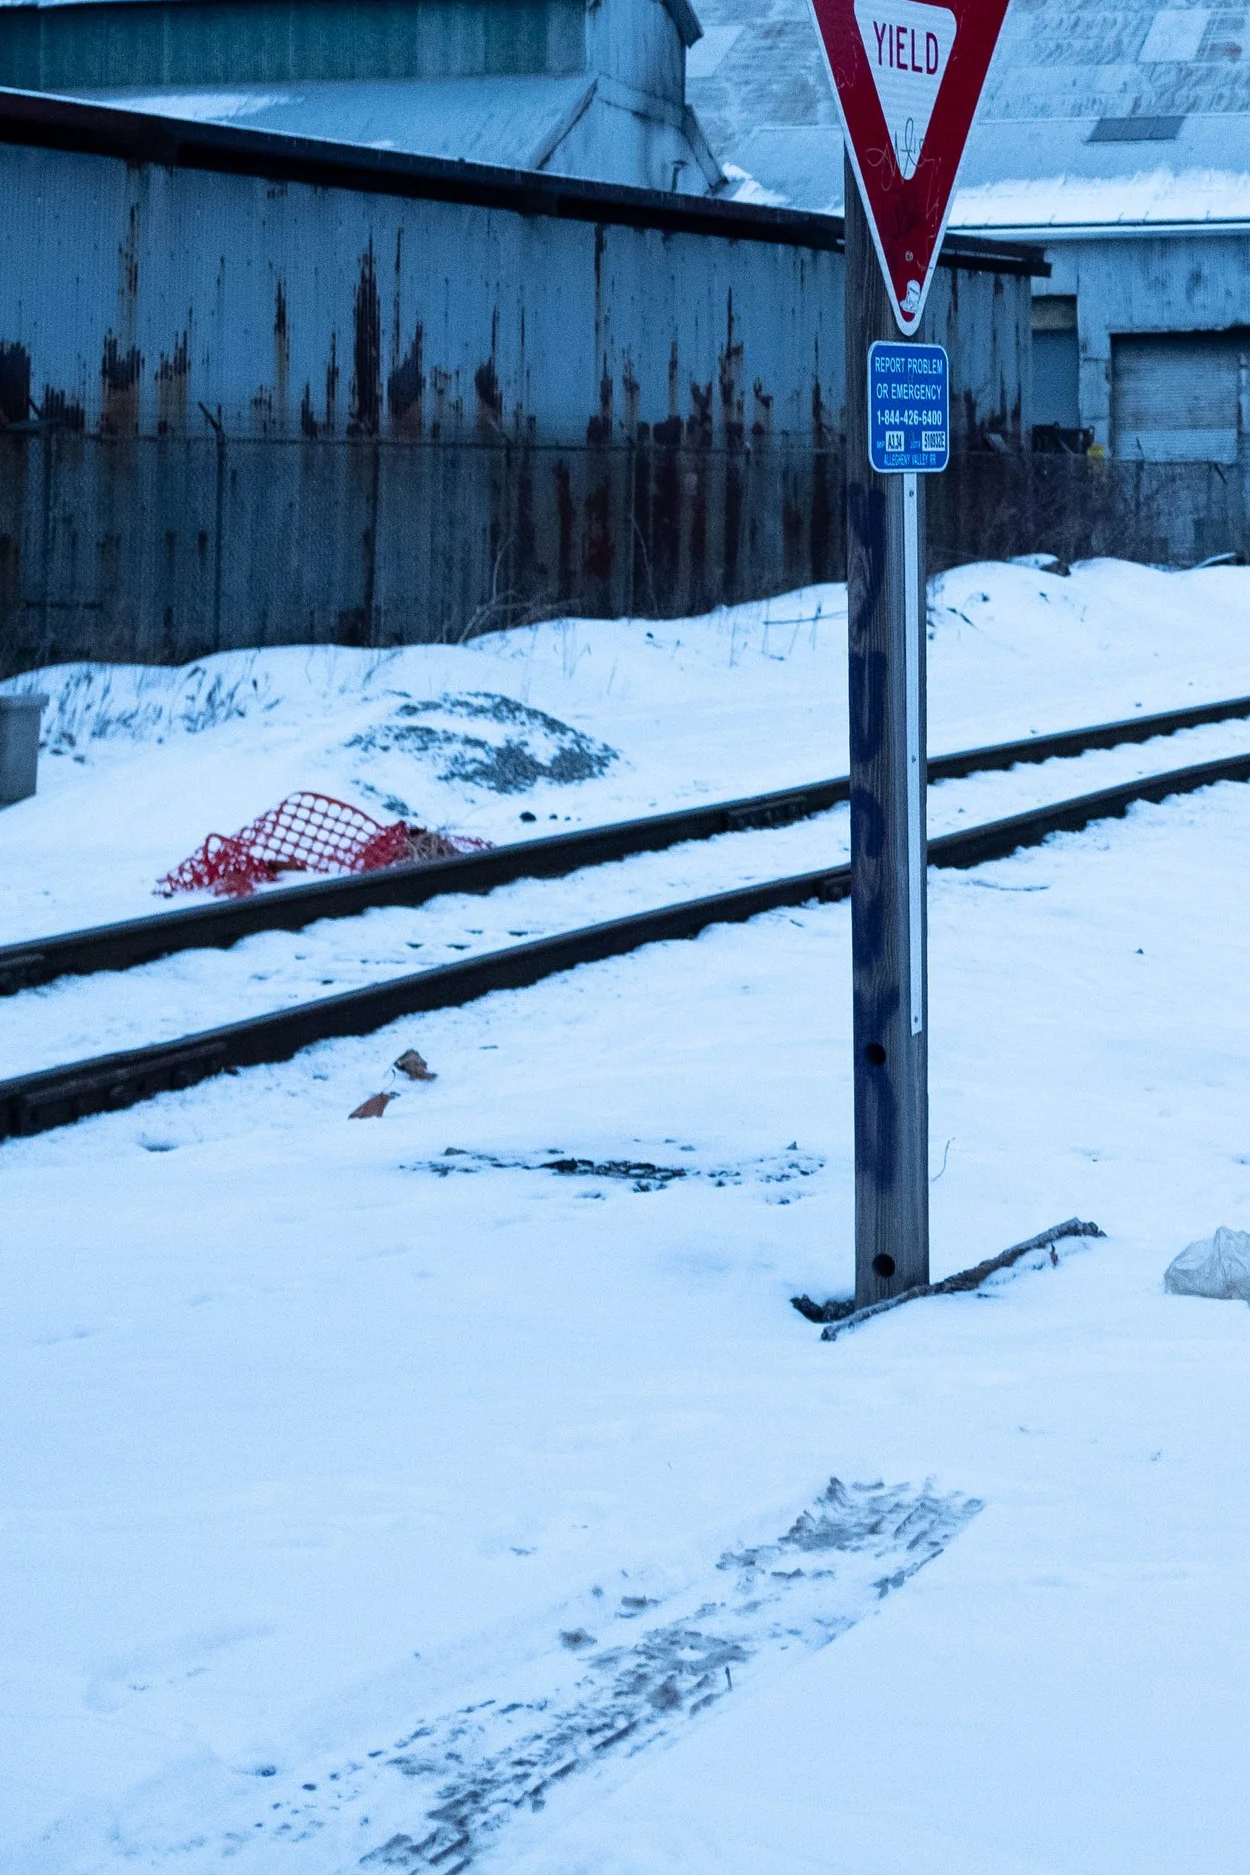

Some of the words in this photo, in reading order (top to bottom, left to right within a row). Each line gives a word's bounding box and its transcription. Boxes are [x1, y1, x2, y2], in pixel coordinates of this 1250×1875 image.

[873, 21, 938, 75] YIELD
[875, 357, 905, 373] REPORT
[908, 358, 943, 374] PROBLEM
[876, 383, 889, 399] OR
[891, 384, 941, 400] EMERGENCY
[877, 409, 942, 425] 1-844-426-6400
[911, 453, 928, 466] VALLEY
